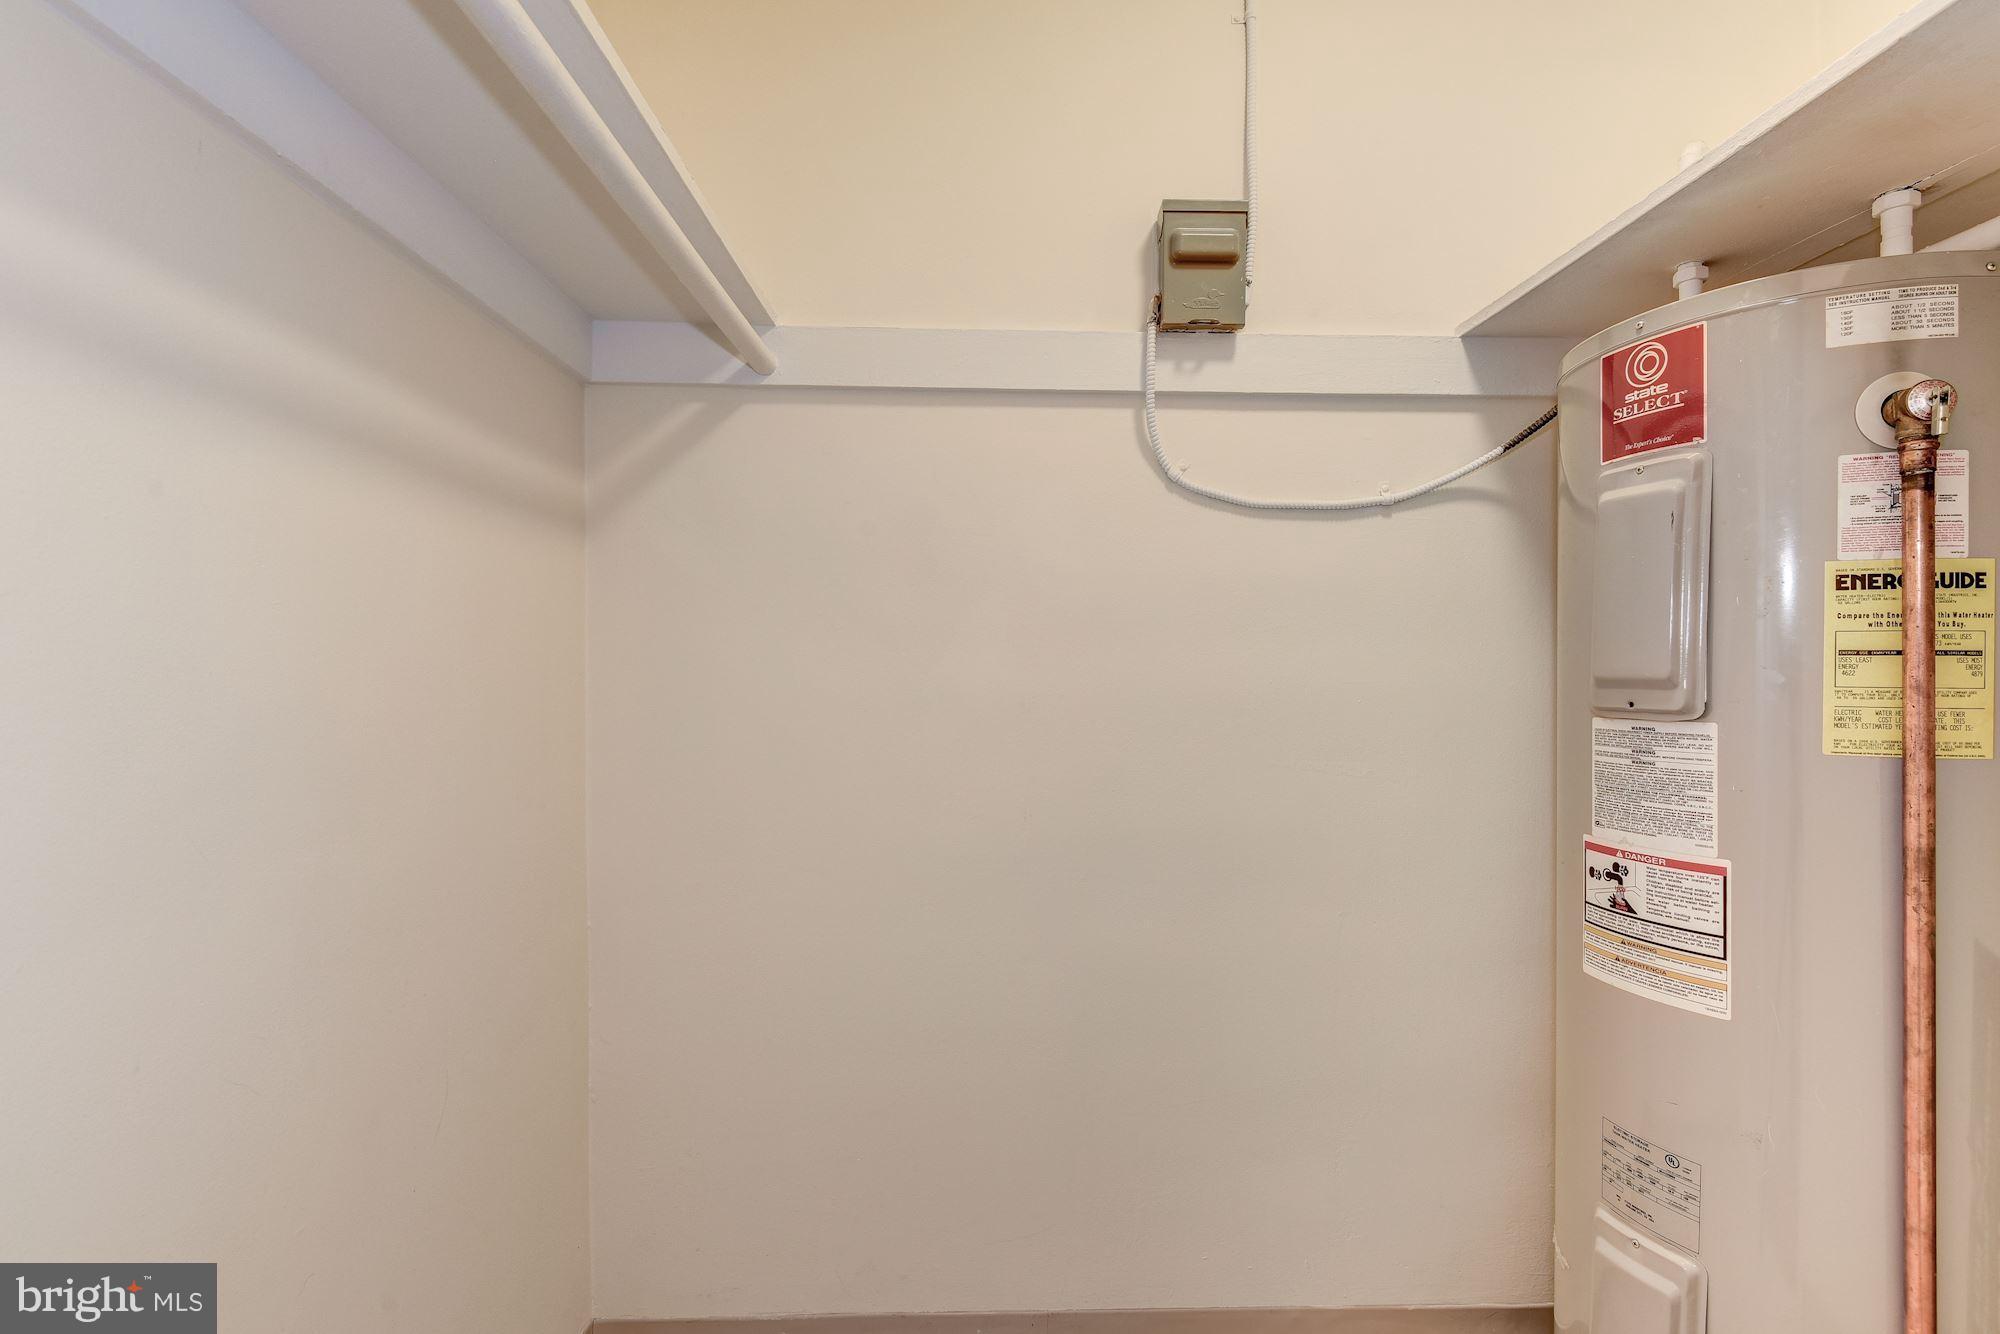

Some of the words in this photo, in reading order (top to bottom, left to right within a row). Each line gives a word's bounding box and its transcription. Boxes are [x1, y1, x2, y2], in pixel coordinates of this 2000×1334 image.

[1828, 293, 1866, 302] TEMPERATURE
[1839, 298, 1870, 306] INSTRUCTION
[1625, 382, 1668, 404] state
[1613, 390, 1686, 420] SELECT
[1633, 438, 1652, 449] Expert's
[1952, 621, 1966, 629] Buy.
[1625, 852, 1666, 866] DANGER
[1646, 906, 1671, 915] Temperature
[1627, 942, 1657, 954] WARNING
[1621, 958, 1667, 975] ADVERTENCIA
